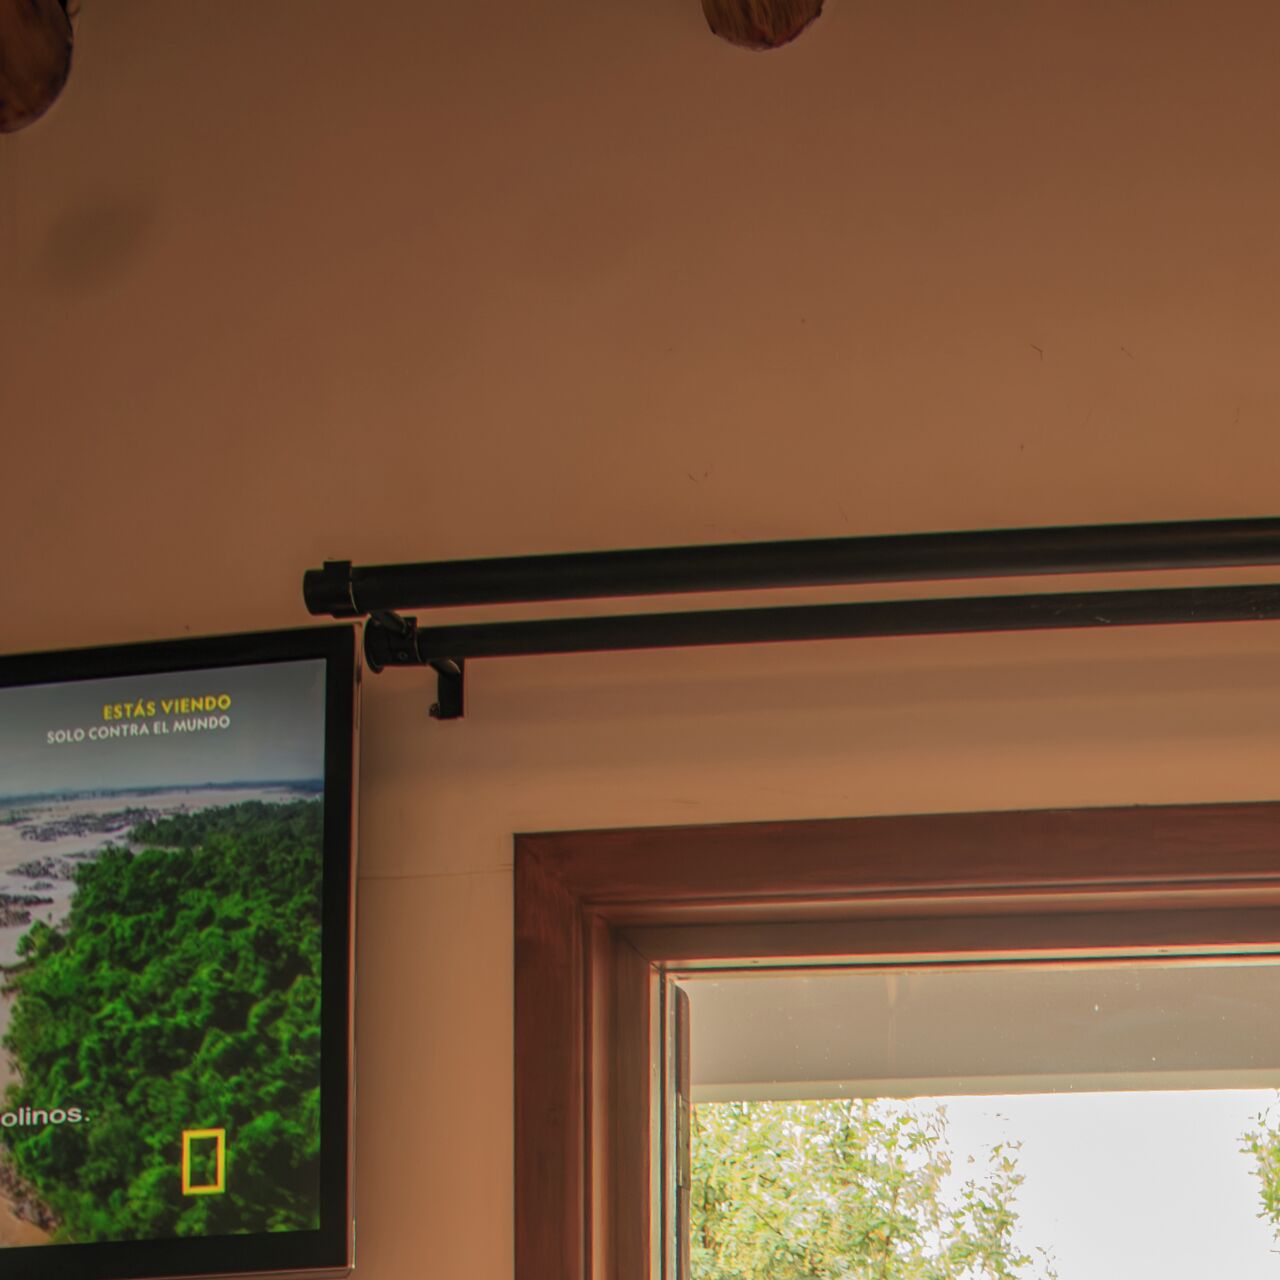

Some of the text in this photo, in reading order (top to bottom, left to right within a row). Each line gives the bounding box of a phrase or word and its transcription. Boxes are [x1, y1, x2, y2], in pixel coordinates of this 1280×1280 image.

[103, 694, 232, 720] ESTÁS VIENDO
[47, 715, 231, 744] SOLO CONTRA EL MUNDO
[0, 1106, 91, 1127] olinos.
